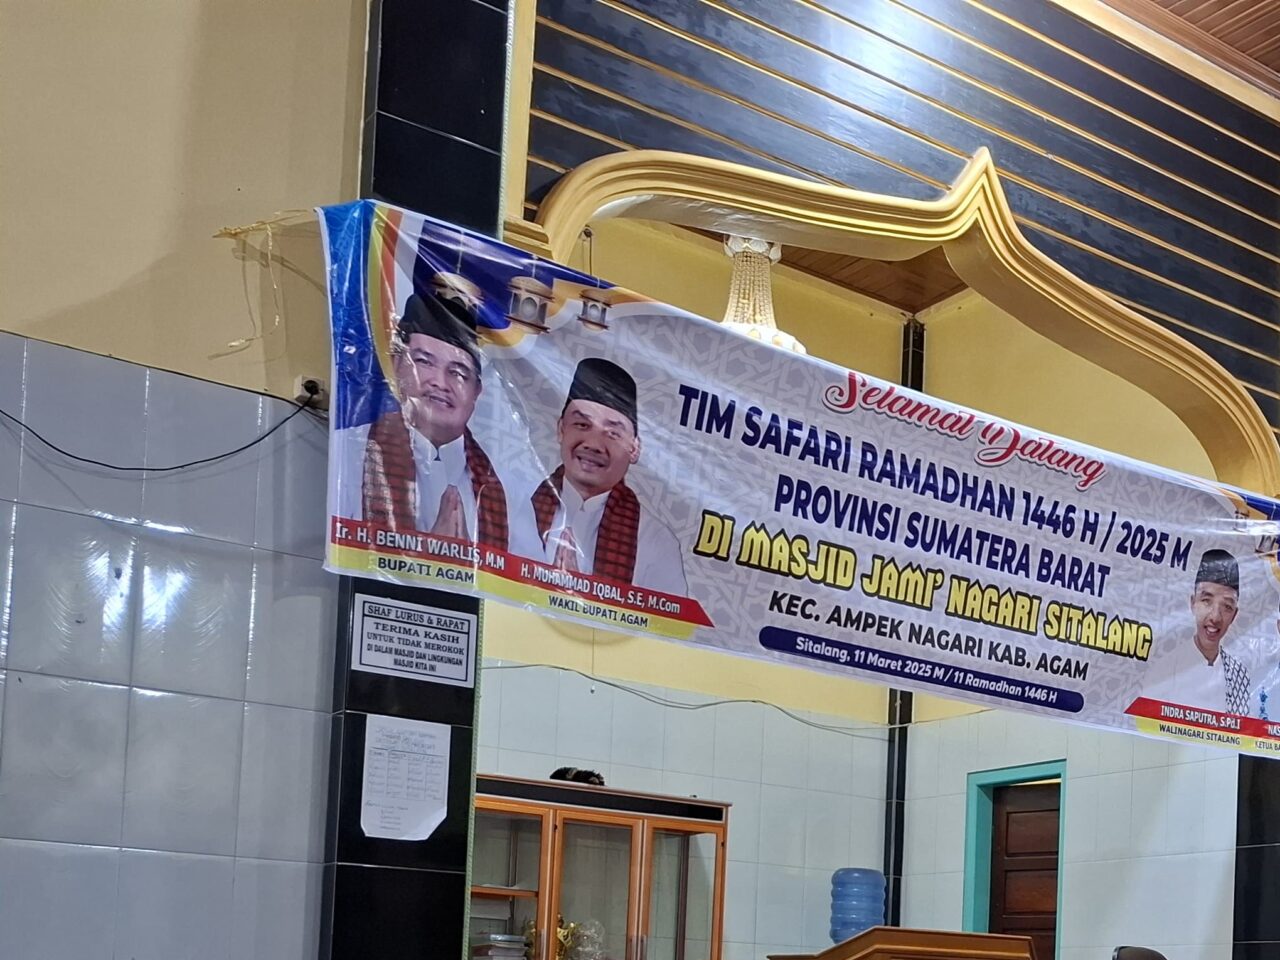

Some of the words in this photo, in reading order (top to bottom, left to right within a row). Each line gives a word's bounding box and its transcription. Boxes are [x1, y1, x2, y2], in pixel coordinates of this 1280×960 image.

[824, 371, 976, 437] Selamat
[976, 421, 1106, 488] Datang
[679, 384, 735, 439] TIM
[741, 406, 852, 473] SAFARI
[858, 442, 1015, 521] RAMADHAN
[1022, 491, 1076, 538] 1446
[1081, 509, 1099, 545] H
[1100, 511, 1116, 552] /
[1116, 521, 1169, 565] 2025
[1170, 537, 1193, 571] M
[335, 522, 351, 540] Ir.
[357, 527, 371, 543] H.
[376, 530, 423, 551] BENNI
[427, 538, 483, 566] WARLIS,
[485, 551, 505, 570] M.M
[774, 474, 901, 542] PROVINSI
[904, 511, 1030, 579] SUMATERA
[1036, 549, 1110, 597] BARAT
[378, 557, 431, 576] BUPATI
[436, 567, 474, 584] AGAM
[694, 509, 735, 560] DI
[736, 520, 857, 590] MASJID
[945, 575, 1042, 635] NAGARI
[1044, 600, 1152, 661] SITALANG
[520, 563, 530, 579] H.
[533, 565, 590, 593] MUHAMMAD
[592, 581, 624, 604] IQBAL,
[648, 595, 680, 613] M.Com
[368, 605, 392, 617] SHAF
[395, 610, 424, 623] LURUS
[427, 616, 433, 624] &
[436, 618, 465, 630] RAPAT
[549, 595, 580, 612] WAKIL
[583, 604, 617, 621] BUPATI
[620, 612, 649, 627] AGAM
[367, 632, 395, 643] UNTUK
[397, 637, 422, 648] TIDAK
[424, 641, 464, 655] MEROKOK
[373, 622, 420, 637] TERIMA
[424, 631, 460, 644] KASIH
[768, 591, 820, 622] KEC.
[826, 605, 904, 641] AMPEK
[909, 622, 983, 658] NAGARI
[988, 640, 1030, 669] KAB.
[1035, 653, 1089, 681] AGAM
[367, 643, 373, 651] DI
[374, 644, 393, 654] DALAM
[394, 648, 414, 658] MASJID
[415, 651, 427, 660] DAN
[428, 653, 463, 666] LINGKUNGAN
[393, 658, 414, 669] MASJID
[415, 661, 427, 671] KITA
[795, 636, 850, 662] Sitalang,
[854, 650, 865, 665] 11
[866, 653, 902, 671] Maret
[904, 661, 932, 677] 2025
[933, 667, 944, 680] M
[954, 671, 965, 685] 11
[965, 674, 1022, 697] Ramadhan
[1023, 685, 1048, 701] 1446
[1048, 691, 1058, 704] H
[1160, 705, 1184, 719] INDRA
[1185, 709, 1218, 727] SAPUTRA,
[1159, 724, 1204, 740] WALINAGARI
[1206, 731, 1240, 746] SITALANG
[1255, 740, 1273, 751] KETUA
